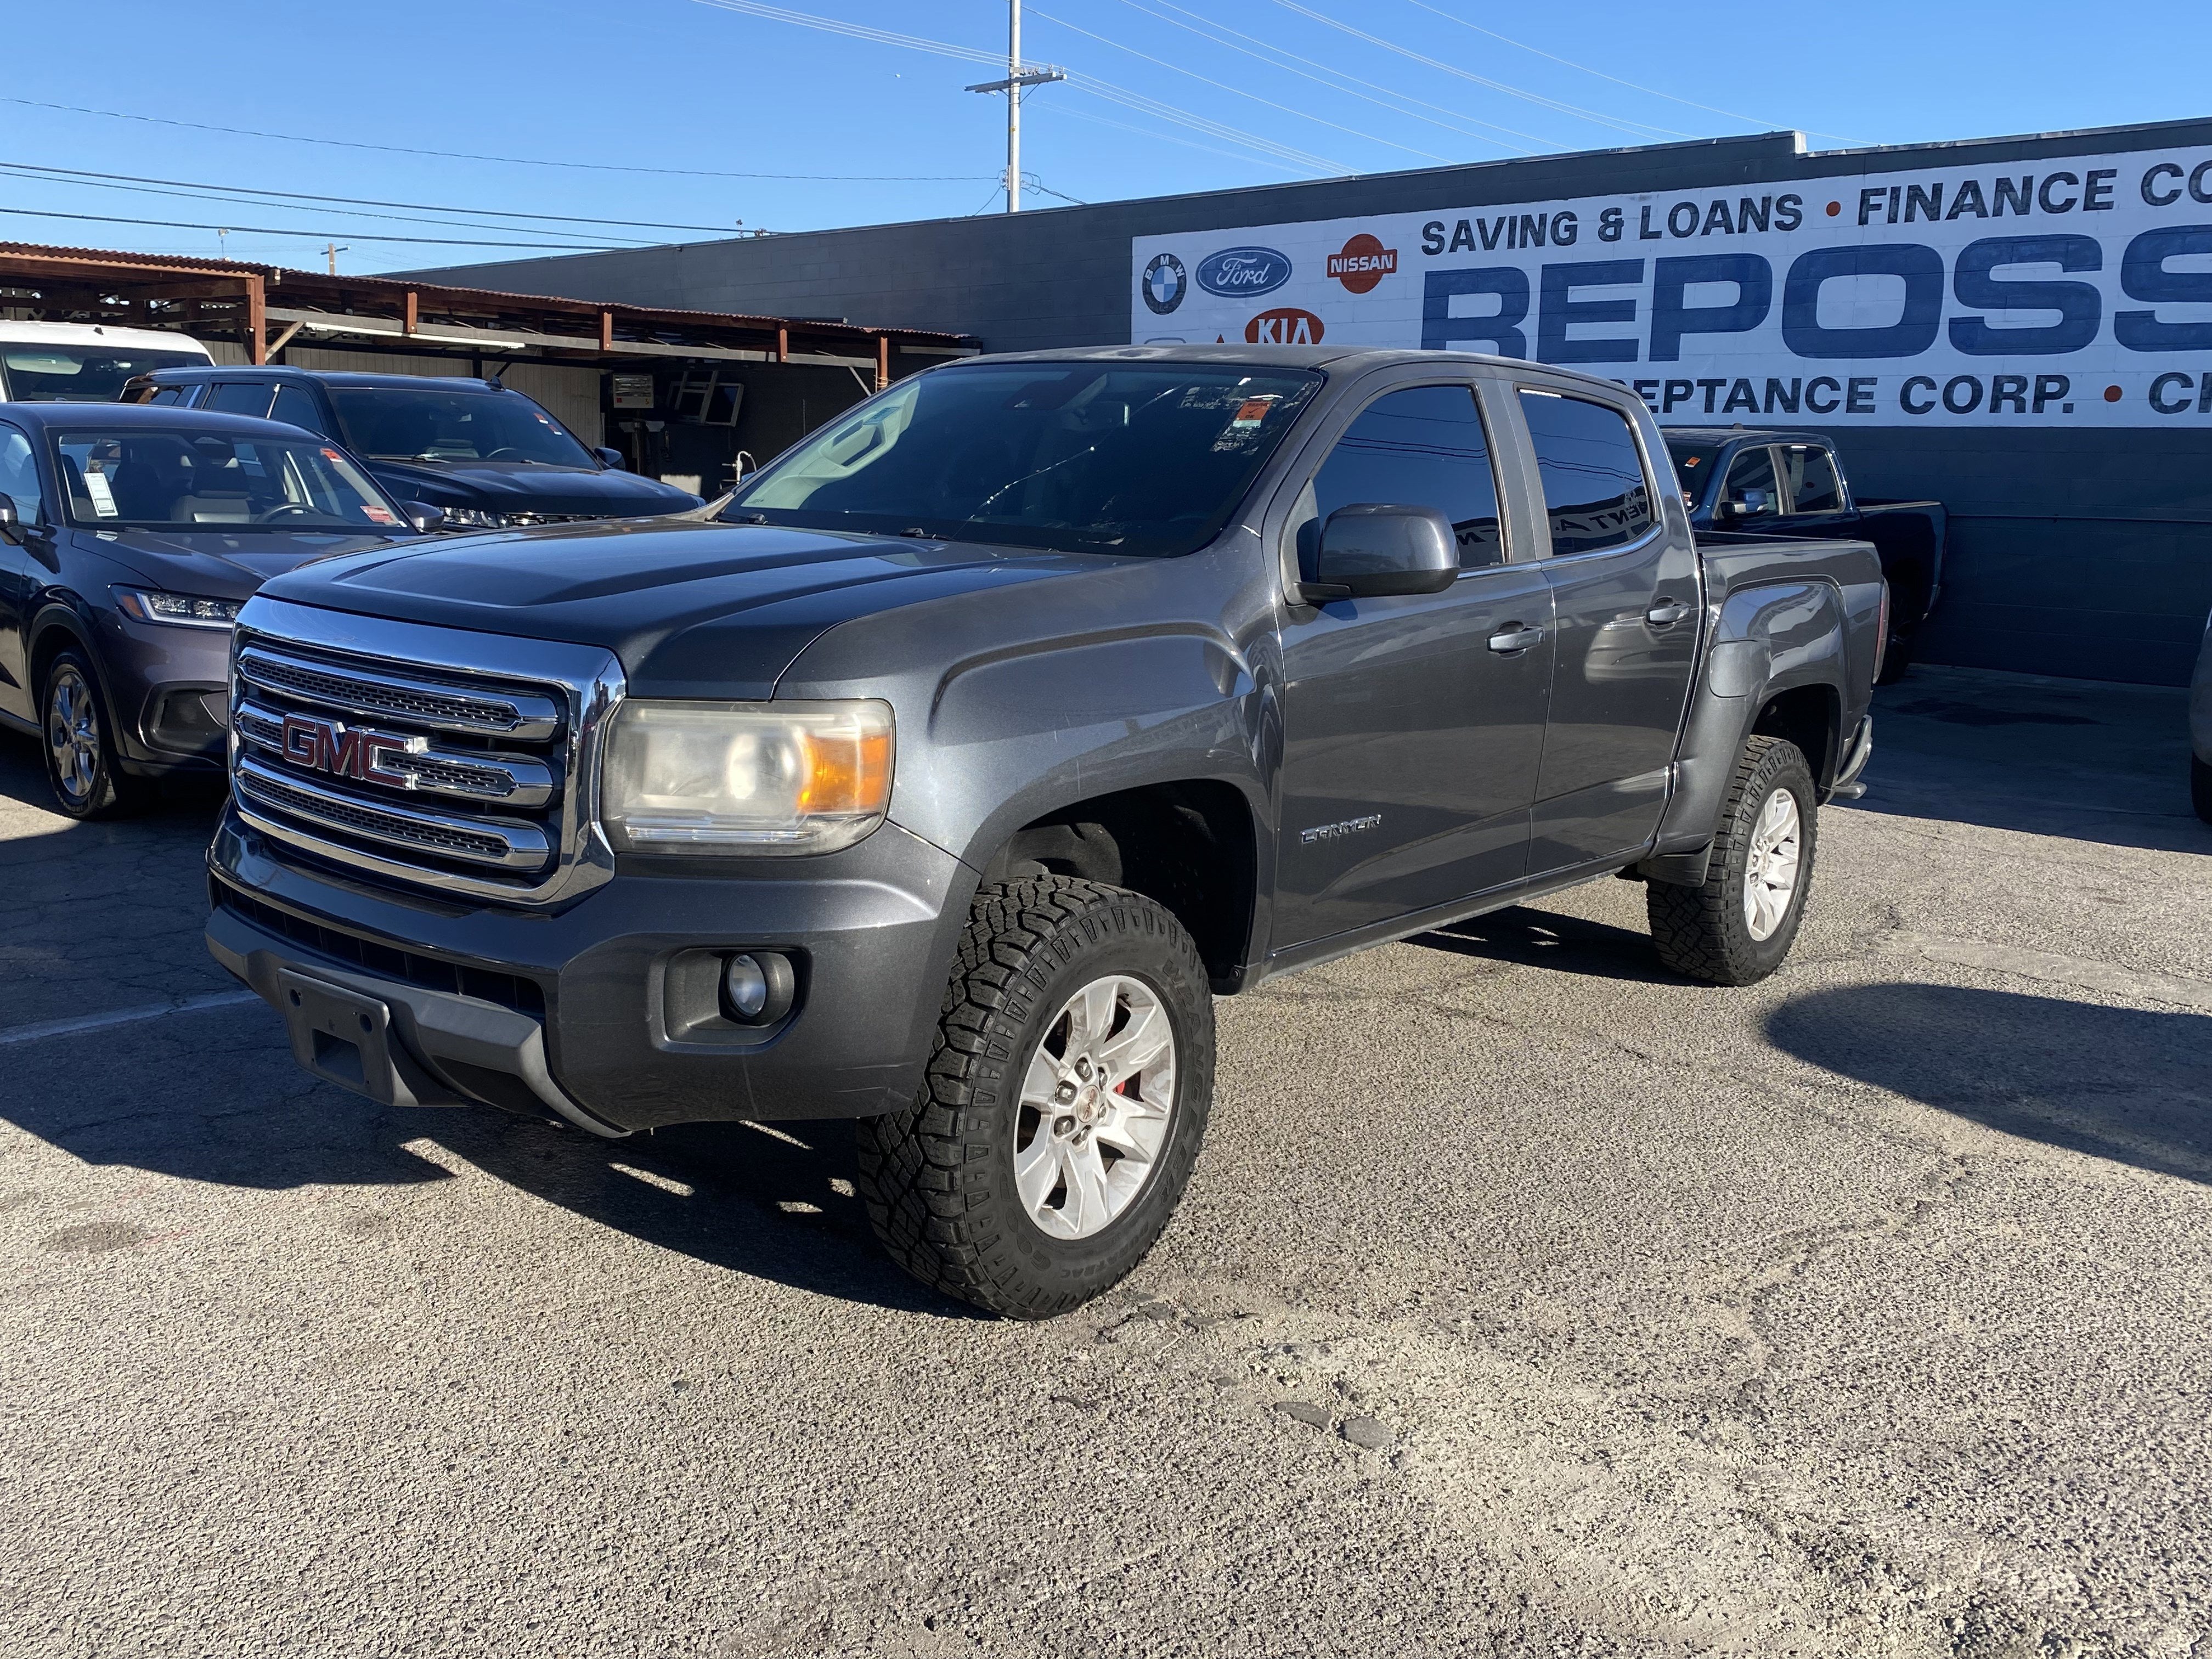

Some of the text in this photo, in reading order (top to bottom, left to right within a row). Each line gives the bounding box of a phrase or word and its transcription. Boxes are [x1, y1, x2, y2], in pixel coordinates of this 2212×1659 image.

[1858, 169, 2118, 225] FINANCE
[1421, 194, 1803, 255] SAVING & LOANS
[1216, 257, 1271, 286] Ford
[1330, 254, 1393, 273] NISSAN
[1421, 224, 2212, 363] REPOSS
[1257, 317, 1313, 344] KIA
[1610, 374, 2074, 415] EPTANCE CORP.
[283, 713, 418, 791] GMC
[1300, 814, 1381, 844] CANYON
[1159, 958, 1205, 1205] WRANGLER
